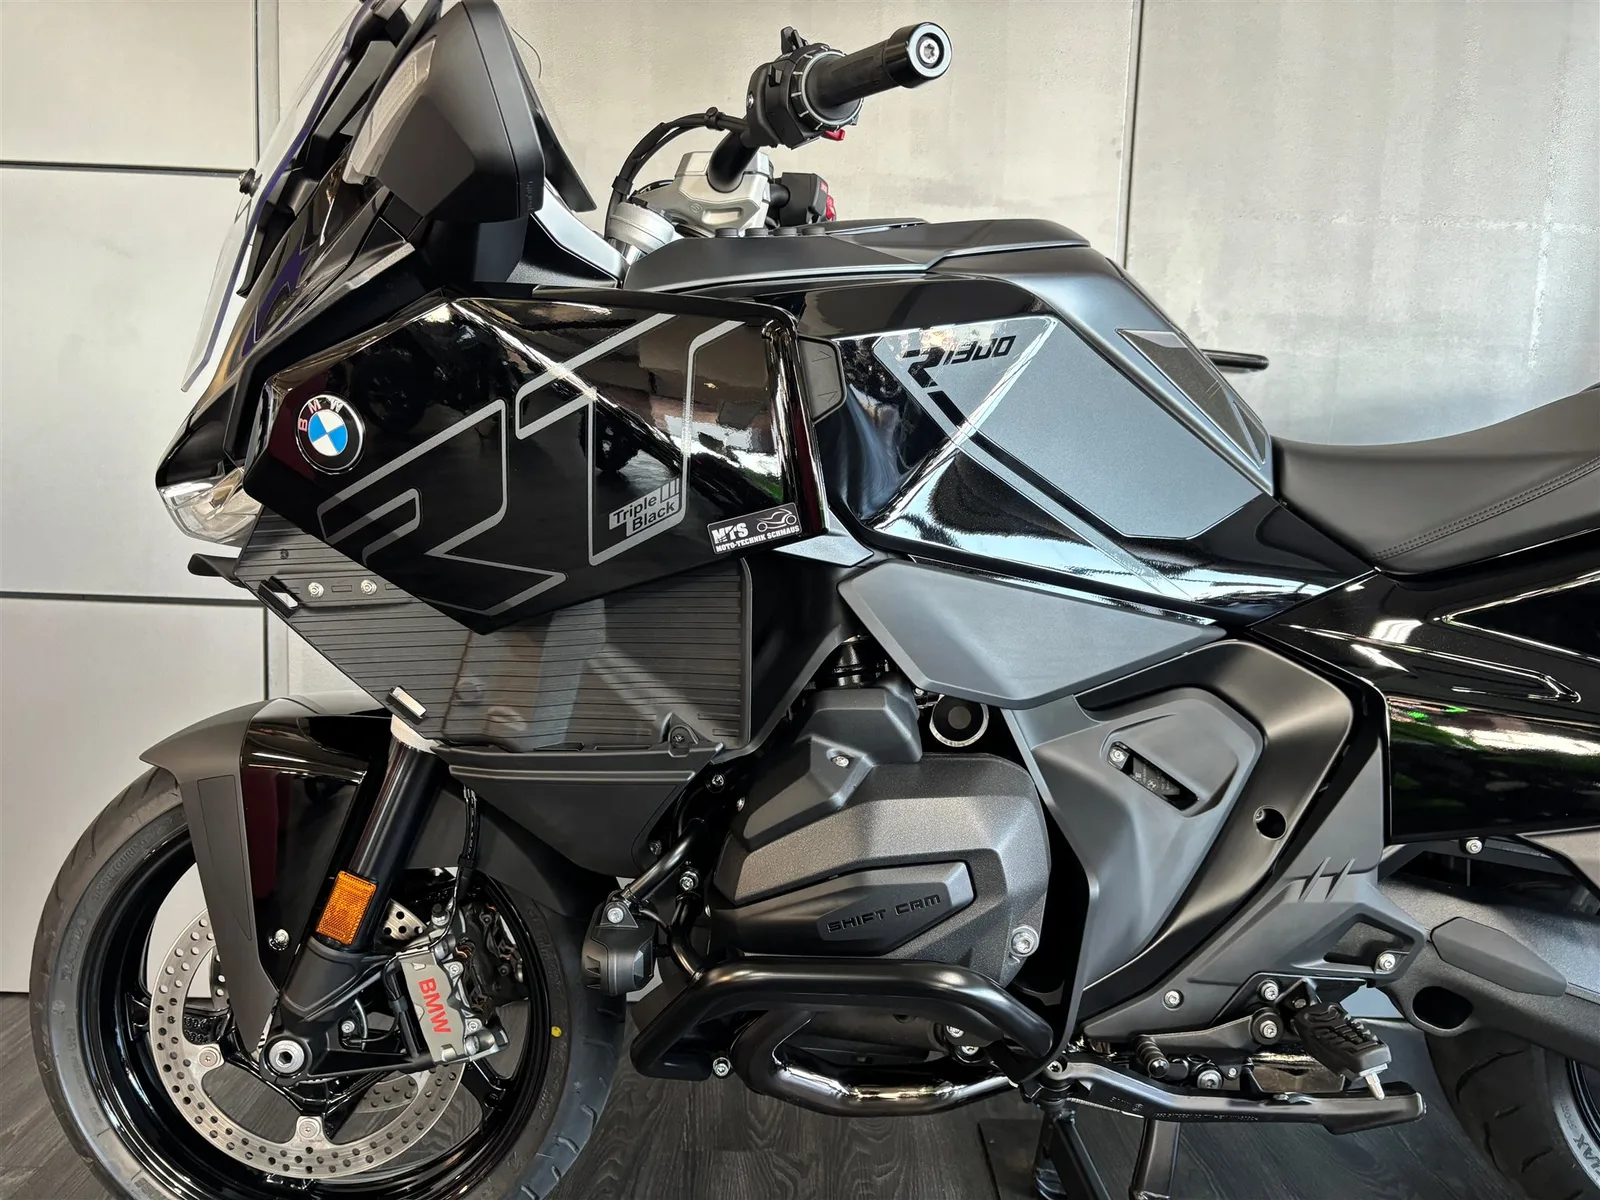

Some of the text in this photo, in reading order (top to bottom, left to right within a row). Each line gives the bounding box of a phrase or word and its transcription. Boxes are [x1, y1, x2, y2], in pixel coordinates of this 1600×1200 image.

[298, 398, 344, 432] BMW
[613, 496, 657, 524] Triple
[633, 501, 675, 531] Black
[711, 522, 749, 544] MTS
[715, 525, 800, 553] MOTO-TECHNIK SCHMAUS
[825, 909, 886, 933] SHIFT
[418, 978, 451, 1032] BMW
